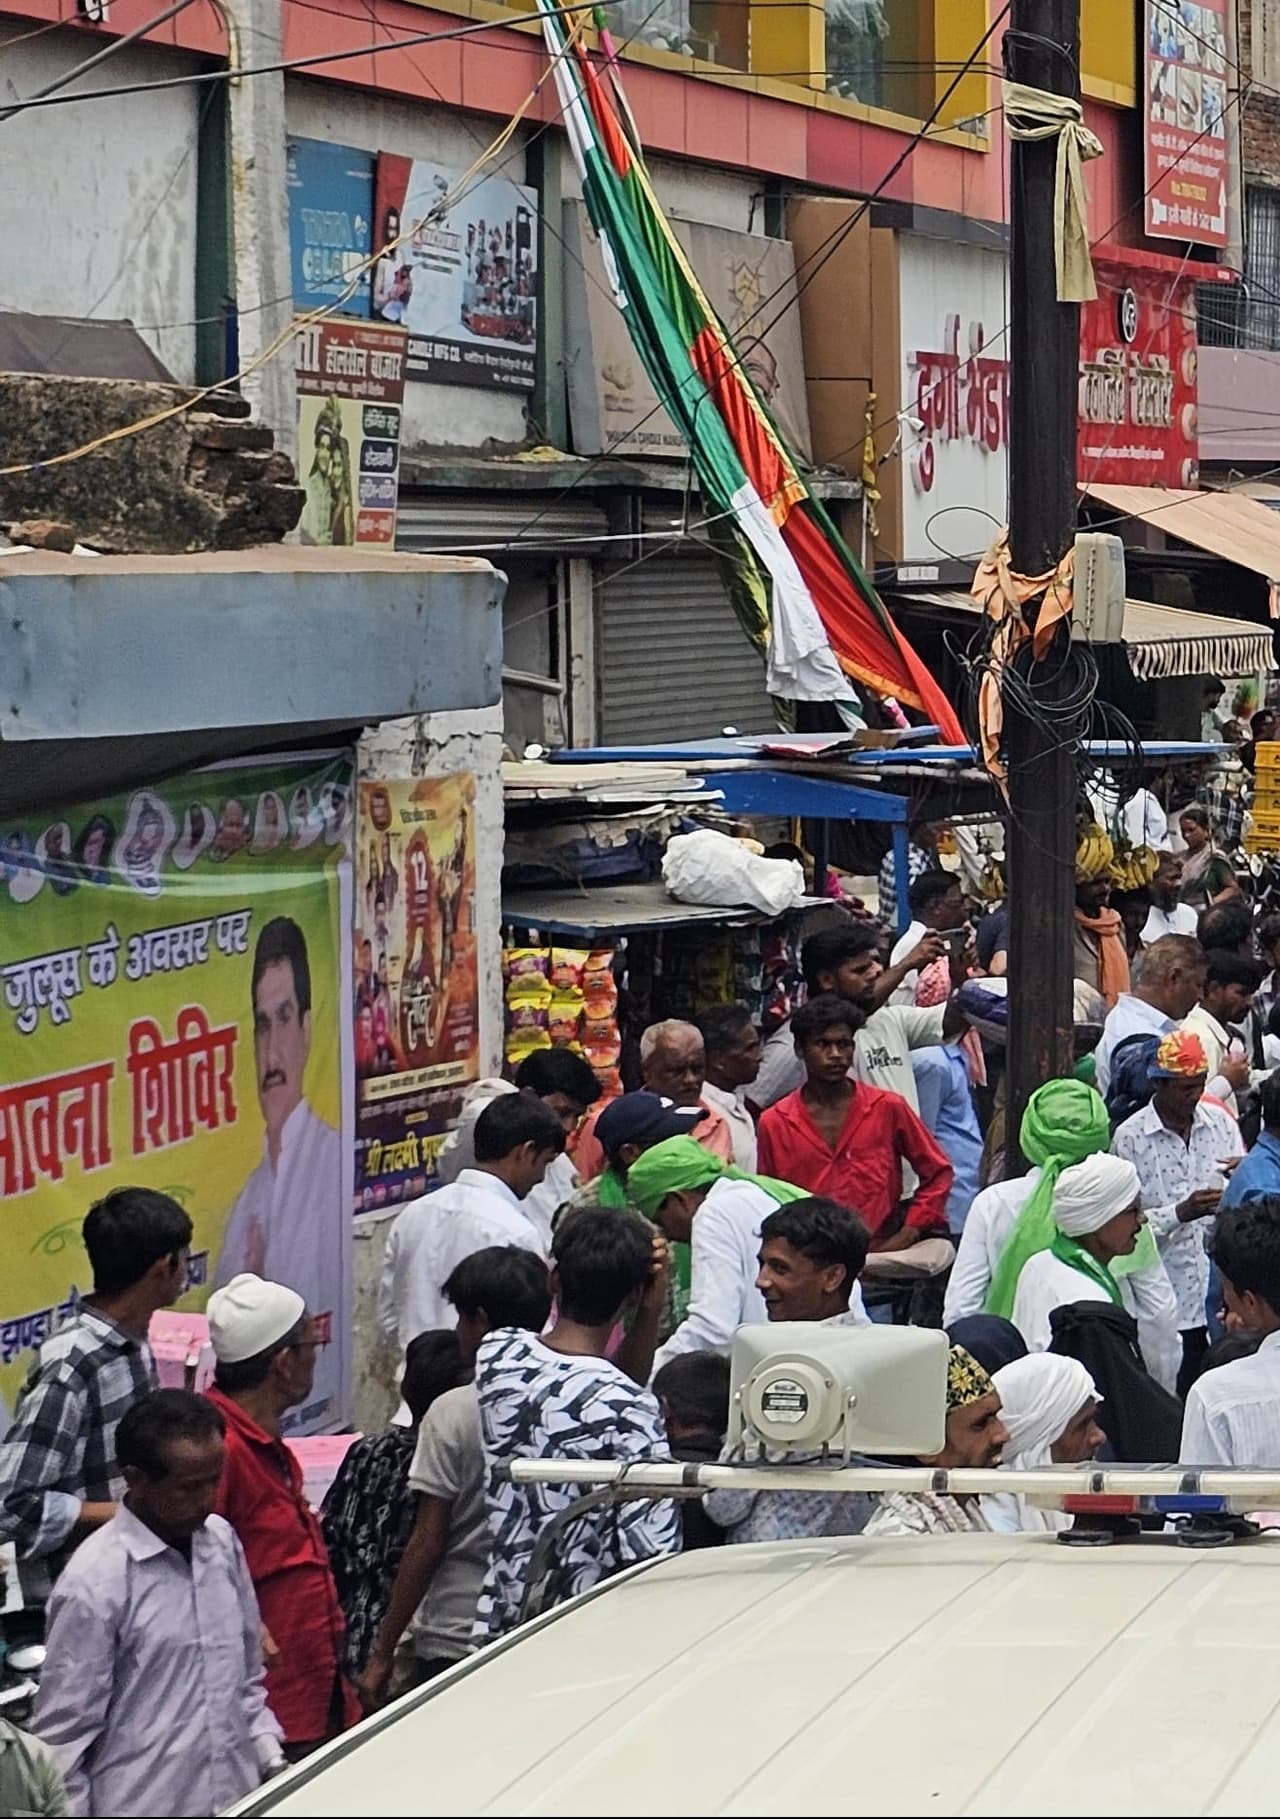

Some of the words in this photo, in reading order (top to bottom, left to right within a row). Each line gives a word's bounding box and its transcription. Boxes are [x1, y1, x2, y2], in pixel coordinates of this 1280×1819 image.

[908, 313, 960, 492] दुर्गा
[966, 320, 1010, 451] भंडा
[2, 950, 83, 1032] जुलूस
[86, 921, 120, 986] के
[126, 916, 211, 980] अवसर
[216, 909, 251, 953] पर
[127, 1005, 238, 1154] शिविर
